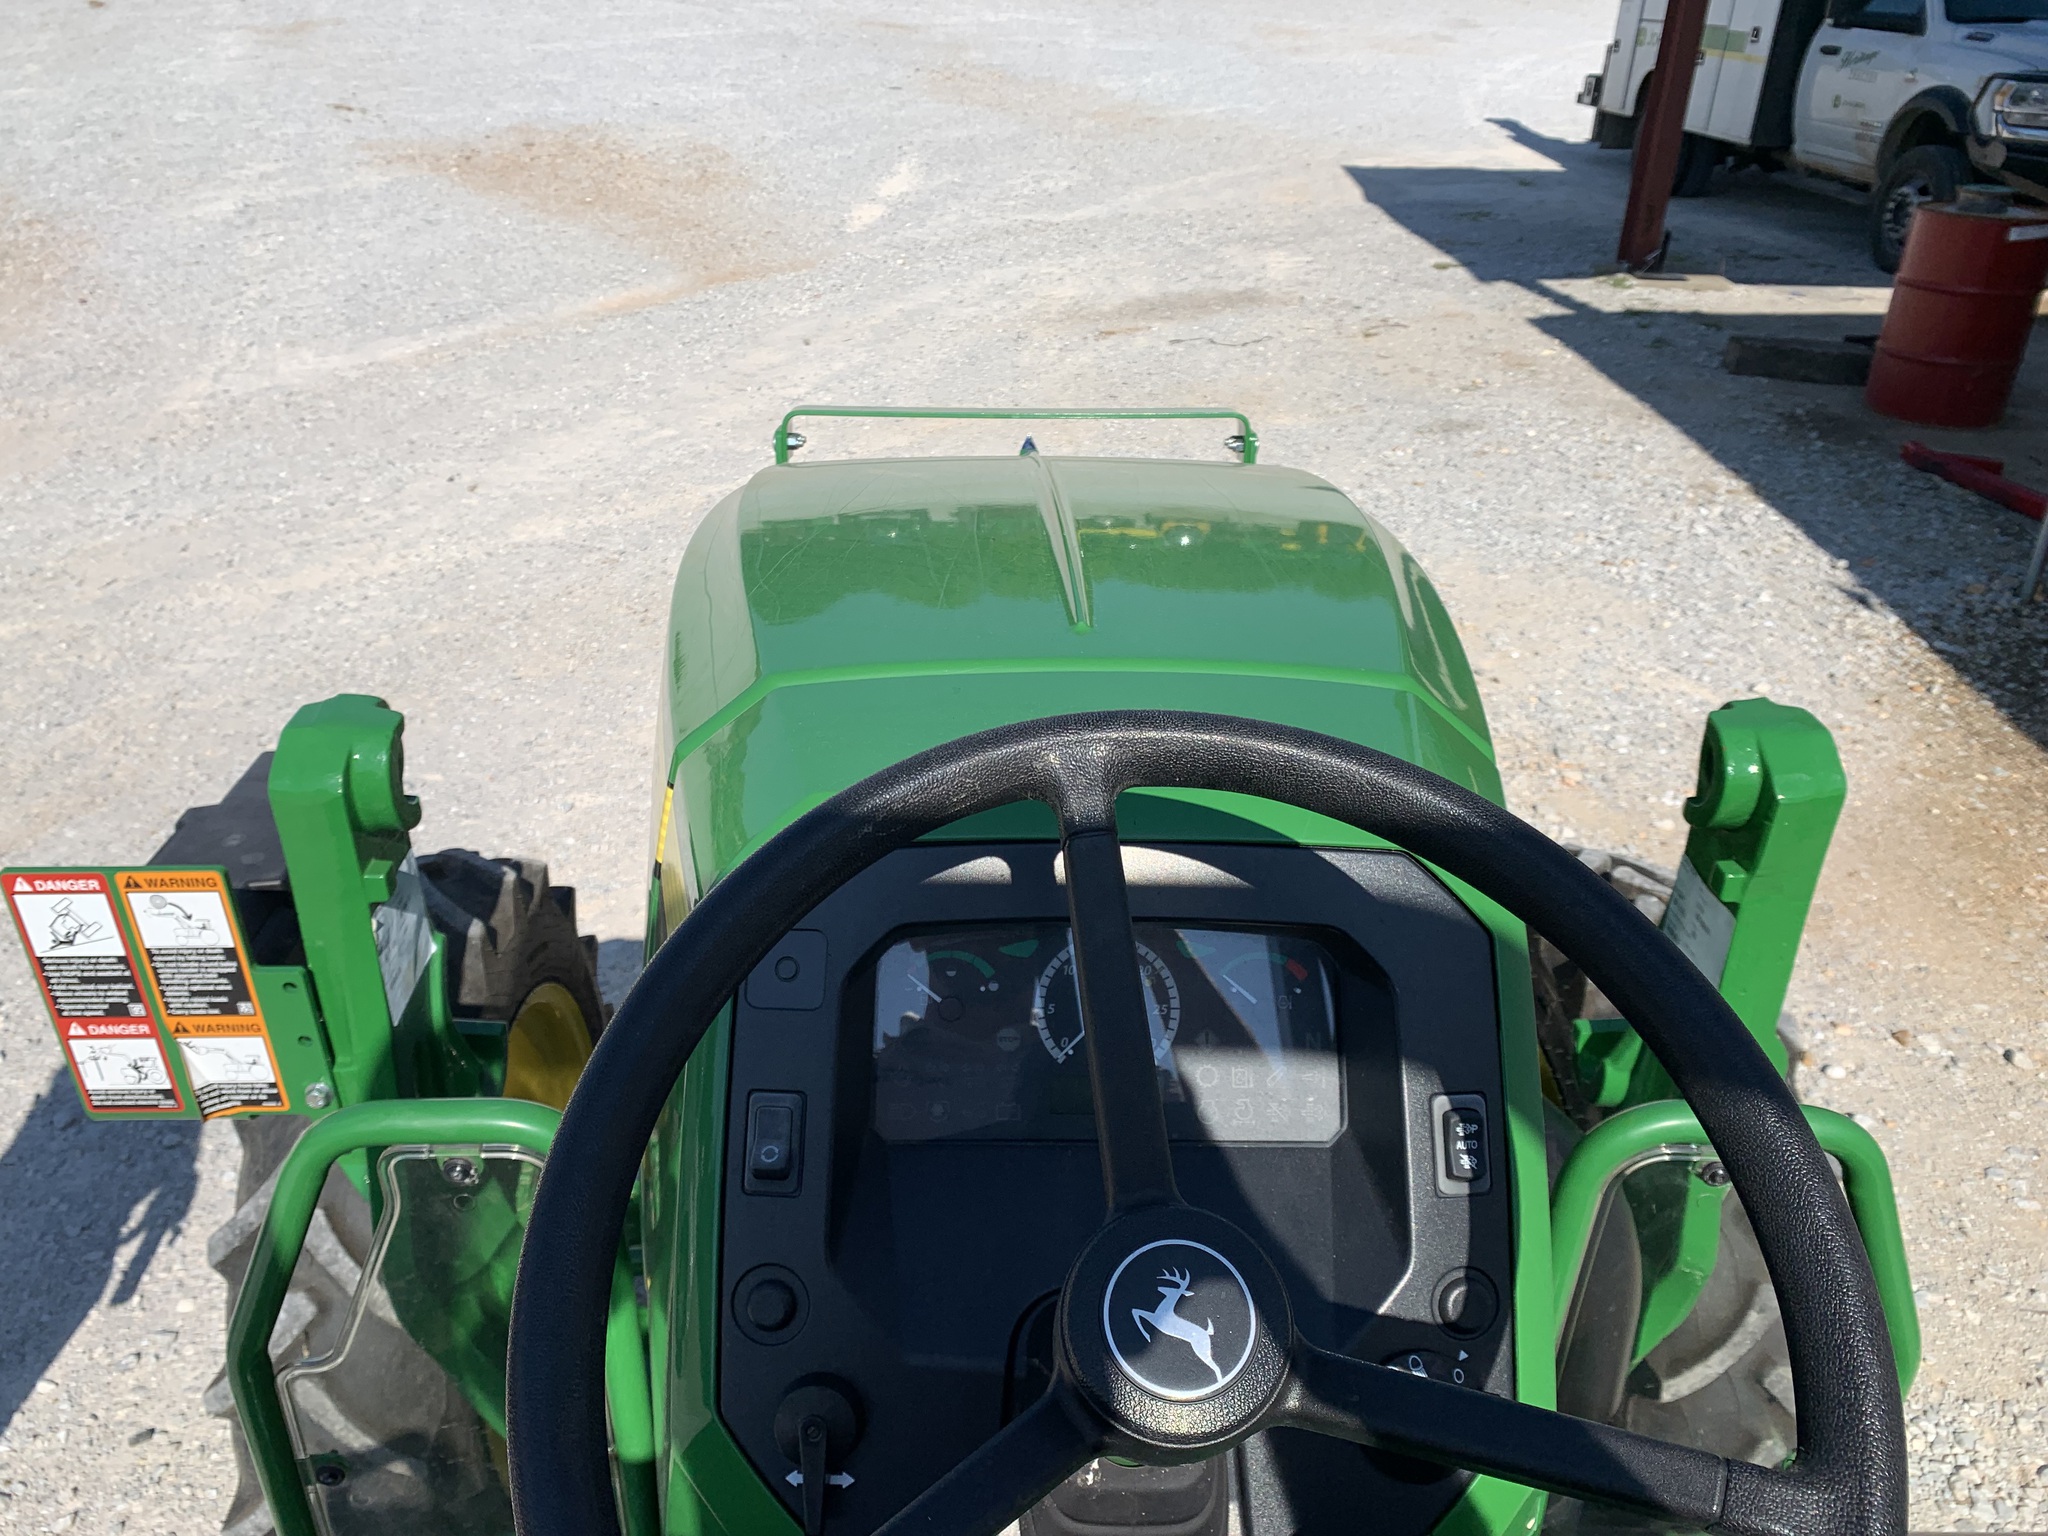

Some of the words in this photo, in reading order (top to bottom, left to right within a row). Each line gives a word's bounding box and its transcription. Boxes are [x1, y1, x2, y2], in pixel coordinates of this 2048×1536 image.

[34, 878, 100, 892] DANGER
[144, 876, 217, 889] WARNING
[1063, 965, 1074, 975] 10
[1047, 1004, 1055, 1014] 5
[1153, 1004, 1168, 1015] 25
[86, 1021, 151, 1036] DANGER
[192, 1021, 262, 1035] WARNING
[1060, 1037, 1069, 1048] 0
[1456, 1140, 1478, 1151] AUTO
